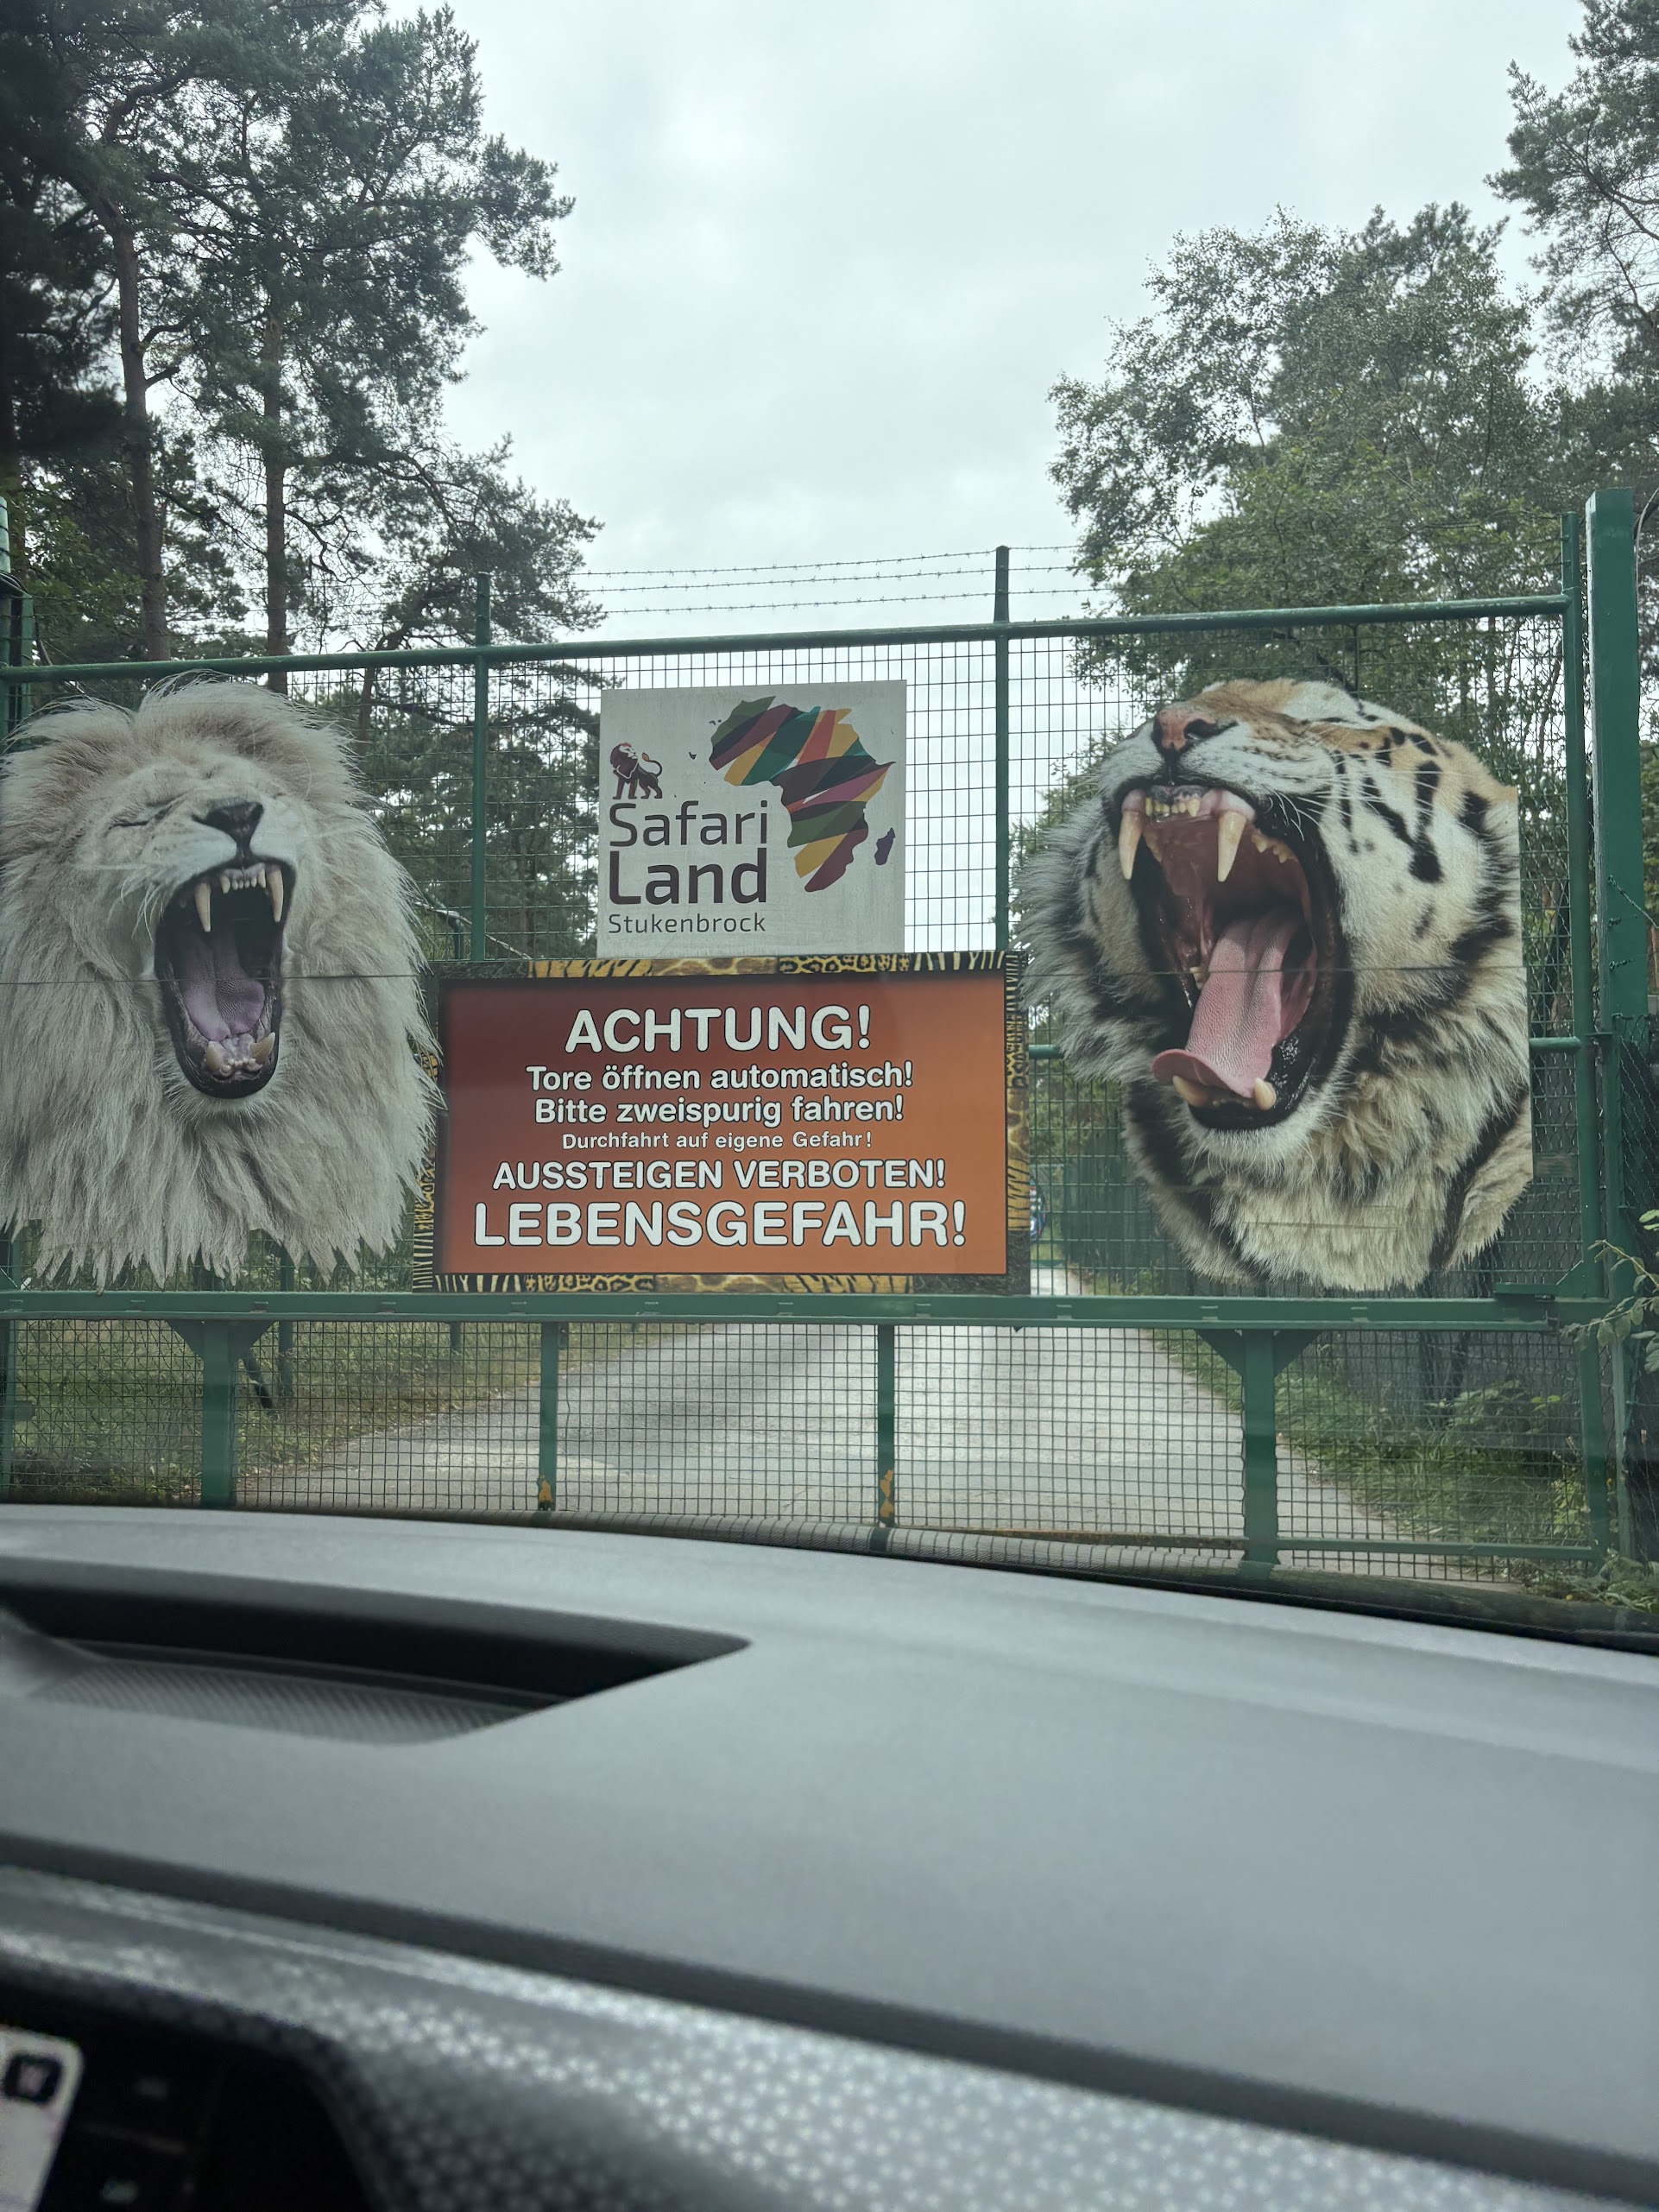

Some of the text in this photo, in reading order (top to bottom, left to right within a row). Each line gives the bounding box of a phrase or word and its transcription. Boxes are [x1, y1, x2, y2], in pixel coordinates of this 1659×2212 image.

[609, 799, 767, 847] Safari
[609, 847, 767, 905] Land
[609, 912, 766, 934] Stukenbrock
[565, 1005, 871, 1053] ACHTUNG!
[526, 1061, 913, 1091] Tore öffnen automatisch!
[534, 1094, 904, 1128] Bitte zweispurig fahren!
[562, 1130, 873, 1152] Durchfahrt auf eigene Gefahr!
[492, 1159, 946, 1191] AUSSTEIGEN VERBOTEN!
[474, 1200, 966, 1247] LEBENSGEFAHR!
